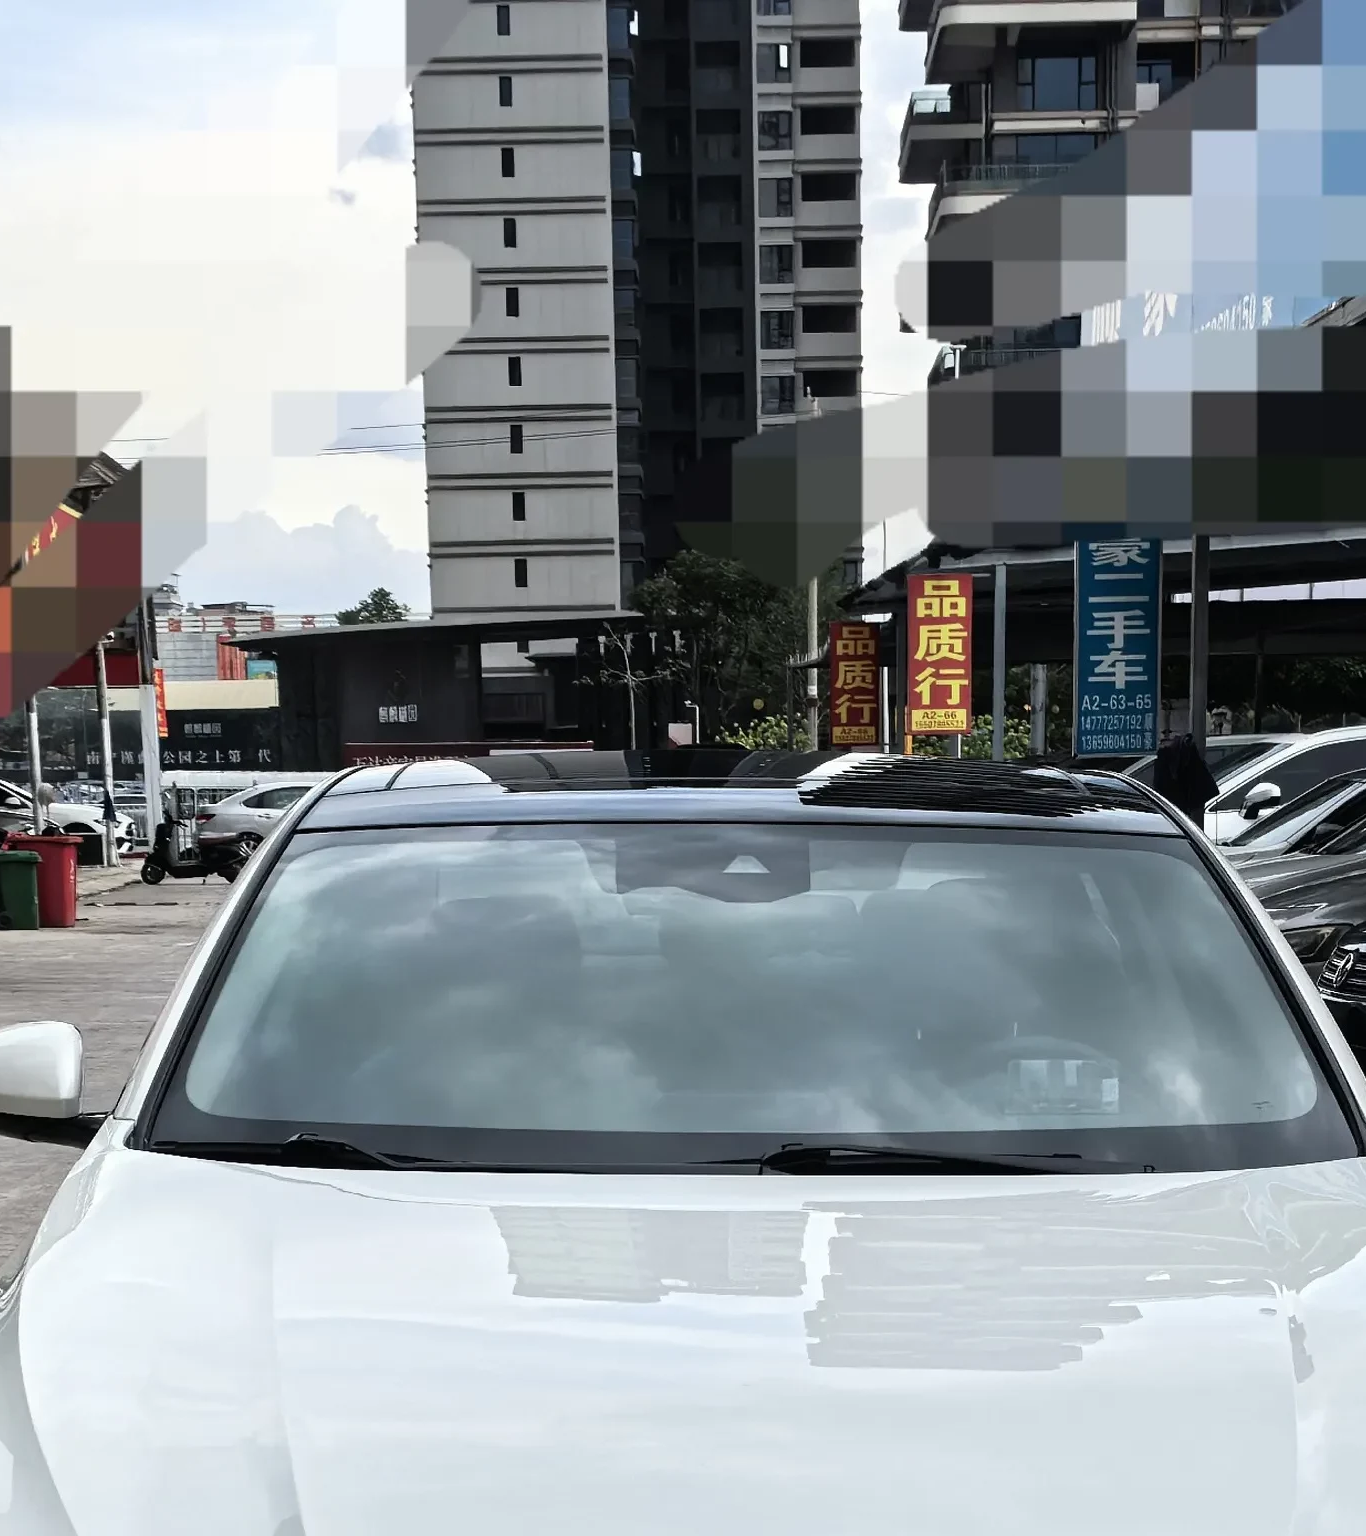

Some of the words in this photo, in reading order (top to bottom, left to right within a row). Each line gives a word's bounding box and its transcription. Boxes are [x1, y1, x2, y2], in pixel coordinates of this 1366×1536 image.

[913, 579, 969, 706] 品质行
[833, 625, 878, 724] 品质行
[1081, 693, 1152, 711] A2-63-65
[921, 710, 958, 720] A2-66
[1081, 733, 1142, 750] 13659604150
